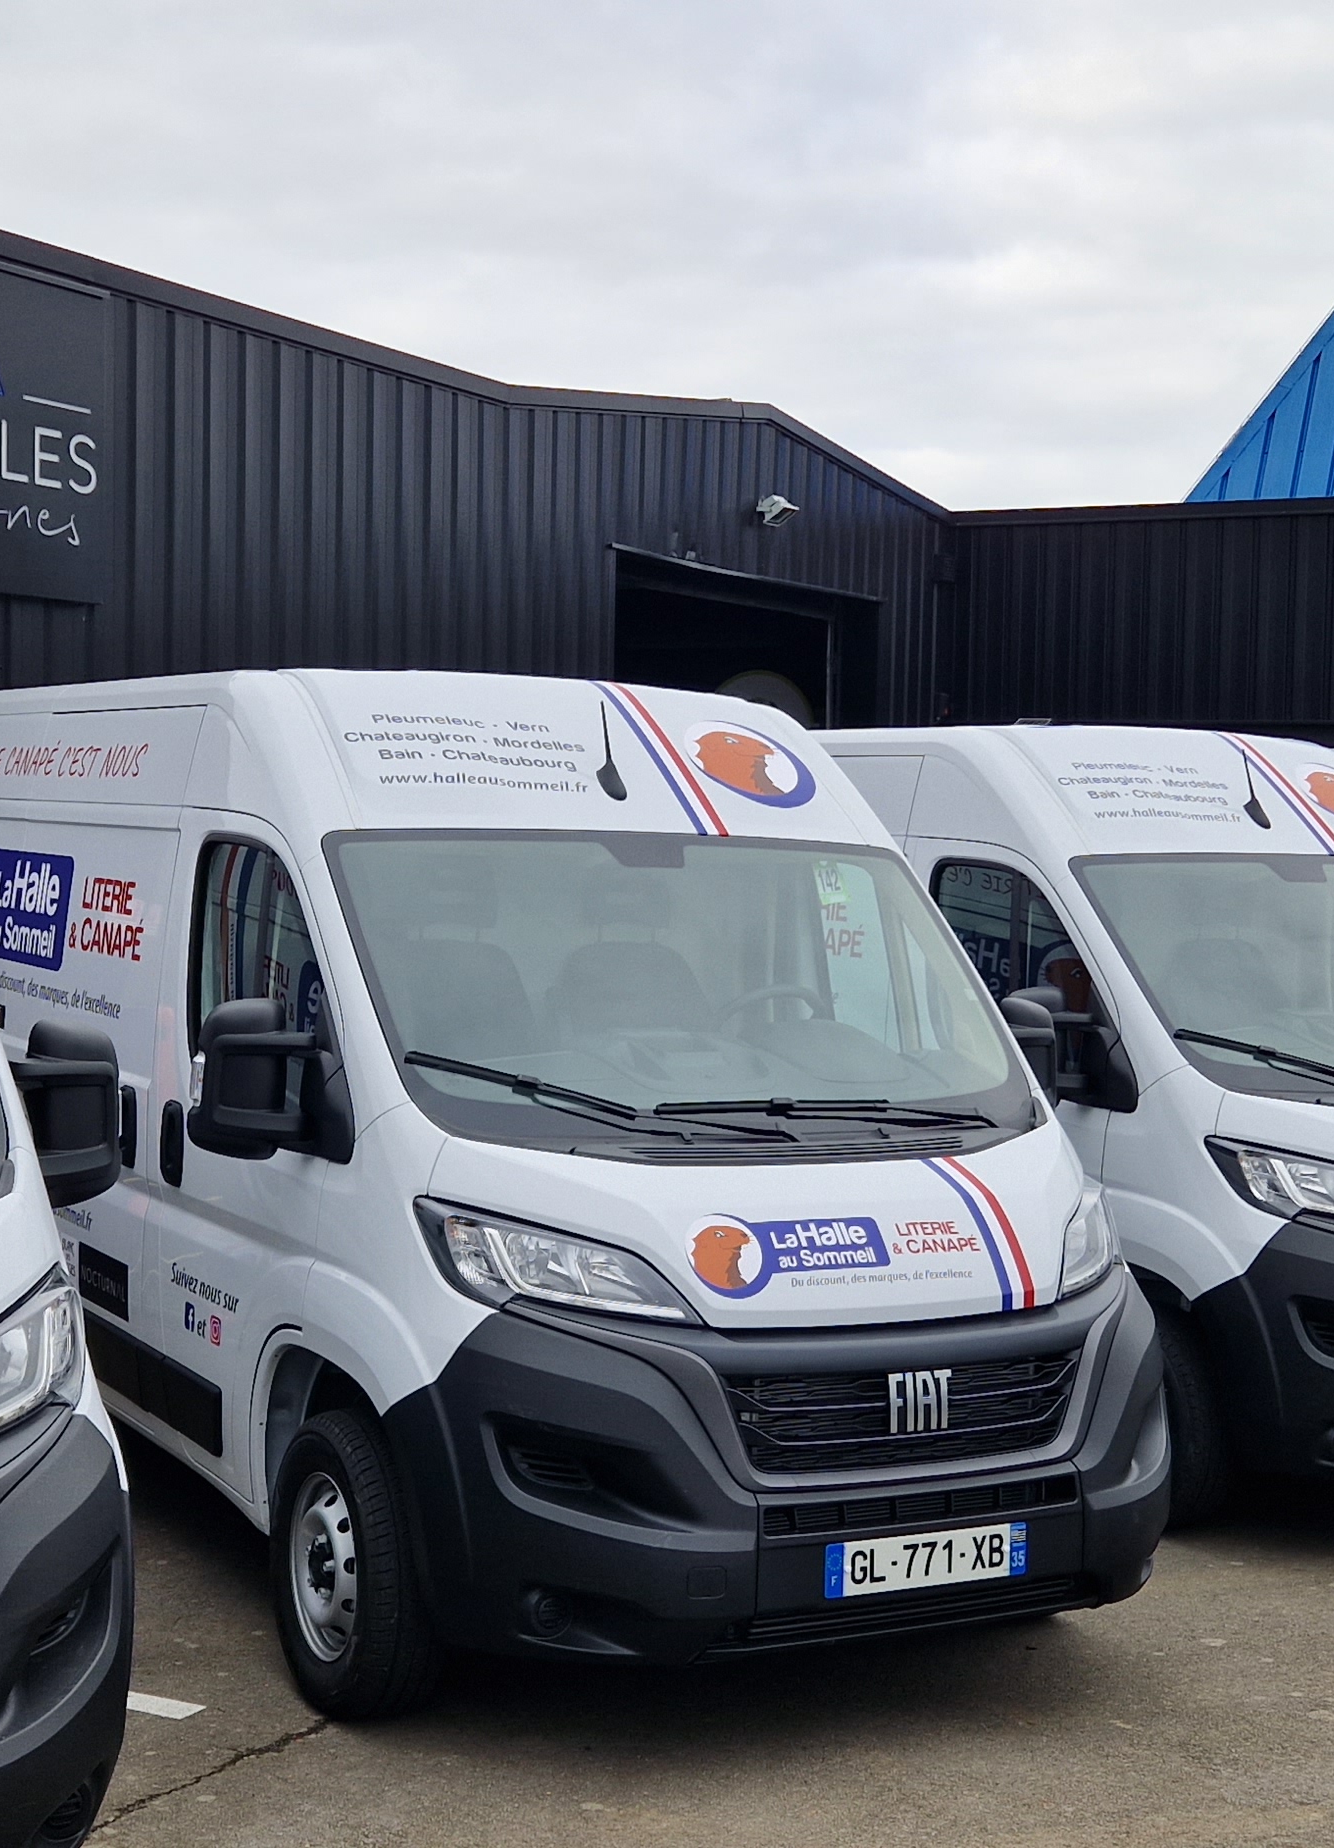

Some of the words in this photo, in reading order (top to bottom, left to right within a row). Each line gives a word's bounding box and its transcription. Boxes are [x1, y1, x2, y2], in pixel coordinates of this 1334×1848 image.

[372, 714, 485, 729] Pleumeleuc
[506, 721, 550, 733] Vern
[344, 731, 477, 745] Chateaugiron
[493, 737, 586, 753] Mordelles
[4, 740, 61, 776] CANAPÉ
[58, 746, 102, 777] C'EST
[99, 743, 148, 779] NOUS
[378, 749, 423, 760] Bain
[442, 749, 577, 772] Chateaubourg
[379, 772, 588, 793] www.halleausommeil.fr
[10, 859, 61, 916] Halle
[818, 868, 841, 893] 142
[82, 876, 136, 916] LITERIE
[3, 916, 56, 959] Sommeil
[68, 922, 76, 949] &
[80, 918, 144, 962] CANAPÉ
[770, 1231, 797, 1250] La
[795, 1221, 867, 1248] Halle
[895, 1221, 959, 1237] LITERIE
[892, 1242, 903, 1255] &
[906, 1234, 981, 1254] CANAPÉ
[778, 1255, 797, 1269] au
[800, 1247, 877, 1267] Sommeil
[171, 1262, 198, 1294] Suivez
[199, 1281, 222, 1306] nous
[223, 1292, 239, 1314] sur
[791, 1277, 804, 1288] Du
[851, 1273, 866, 1284] des
[913, 1270, 924, 1280] de
[197, 1319, 207, 1339] et
[888, 1369, 952, 1434] FIAT
[1012, 1550, 1025, 1567] 35
[831, 1575, 838, 1587] F
